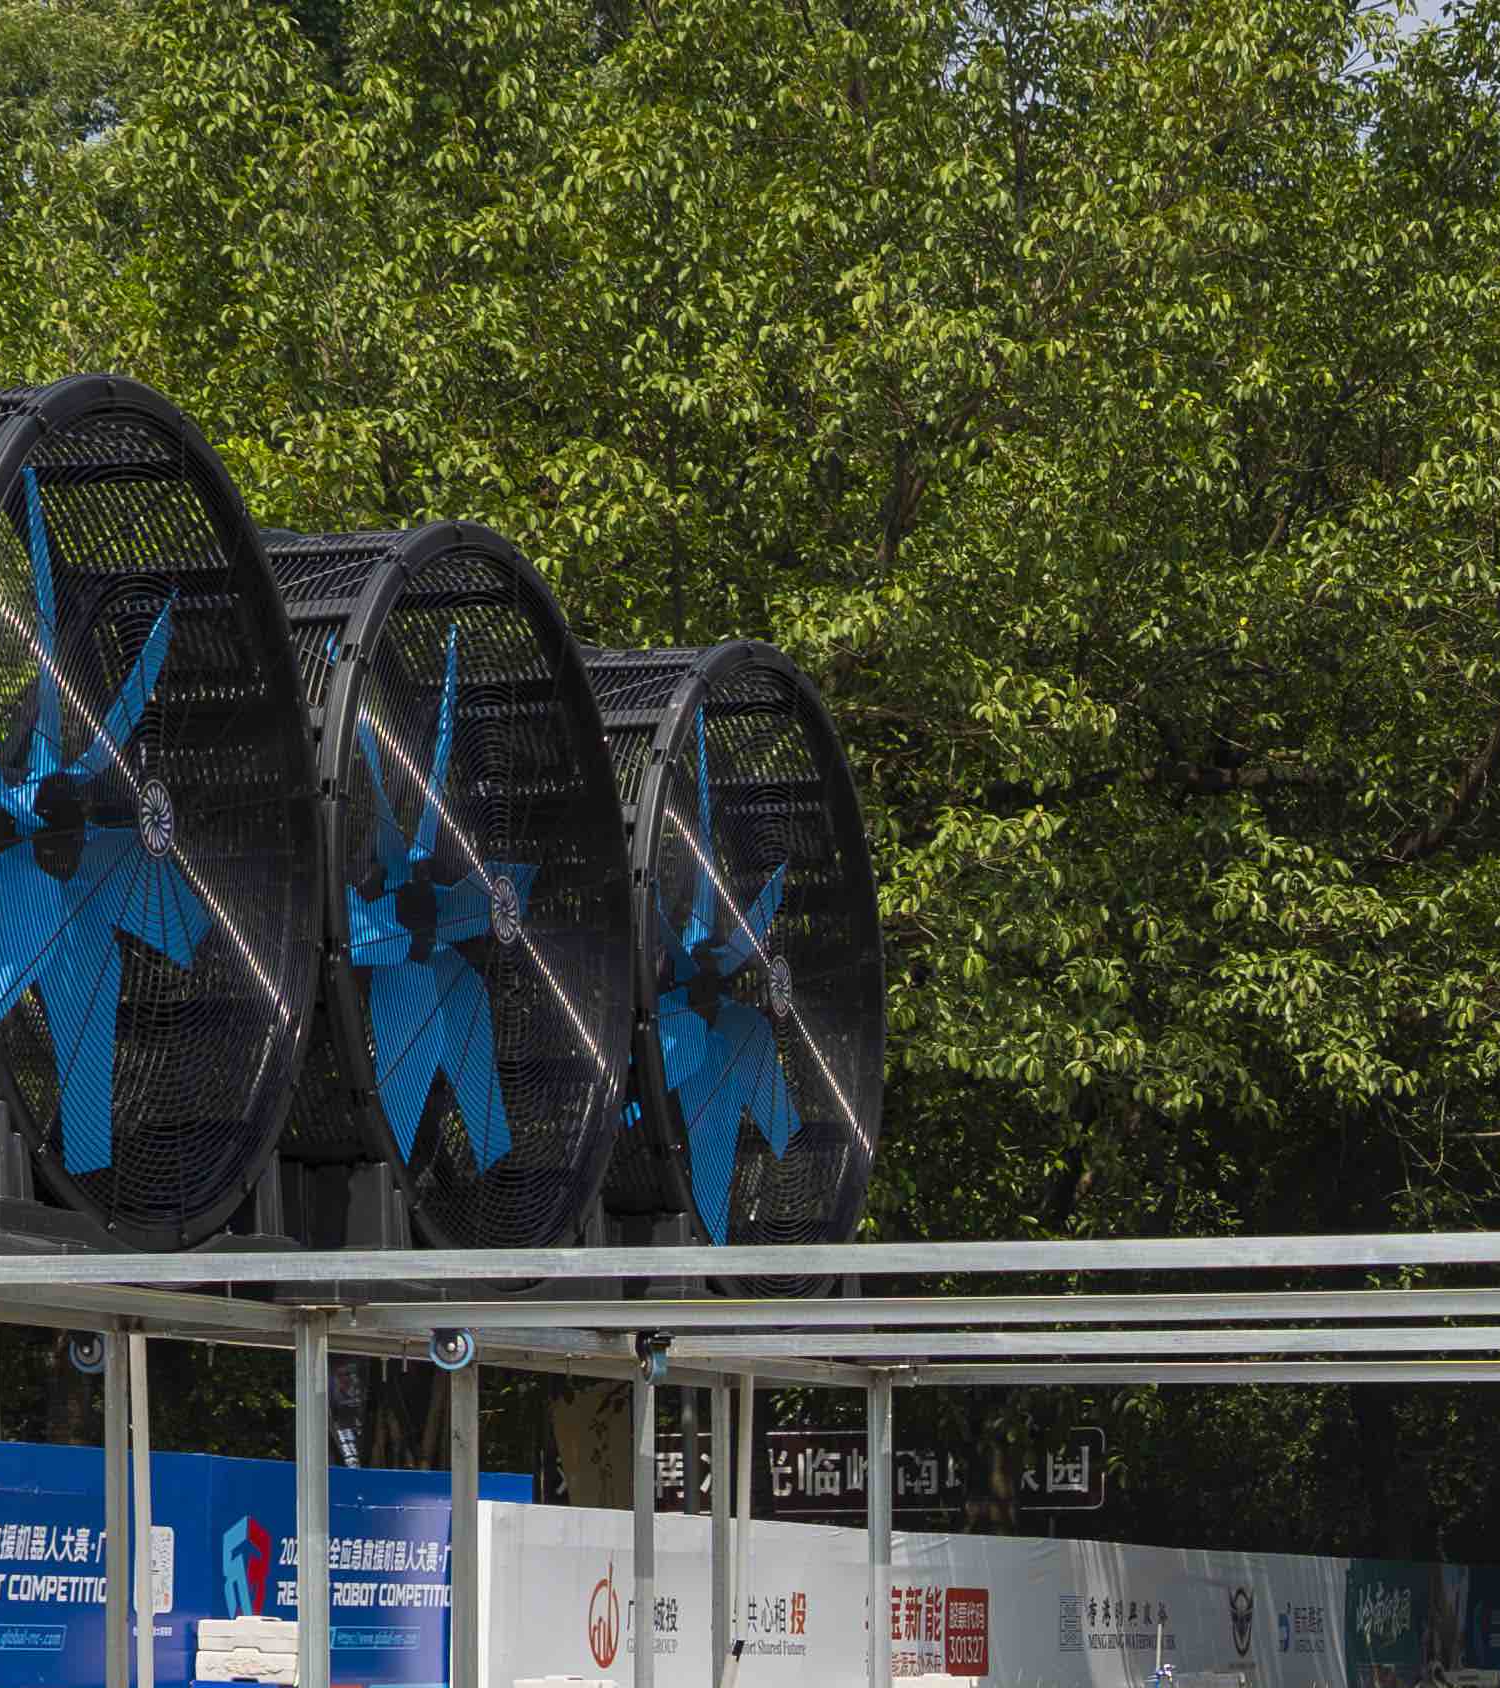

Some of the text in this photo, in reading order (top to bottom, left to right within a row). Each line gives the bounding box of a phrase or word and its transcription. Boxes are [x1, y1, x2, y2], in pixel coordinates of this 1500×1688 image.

[8, 1574, 107, 1603] COMPETITIO
[332, 1581, 378, 1607] ROBOT
[378, 1582, 452, 1608] COMPETITIO
[627, 1596, 678, 1633] 广城投
[949, 1636, 985, 1665] 301327
